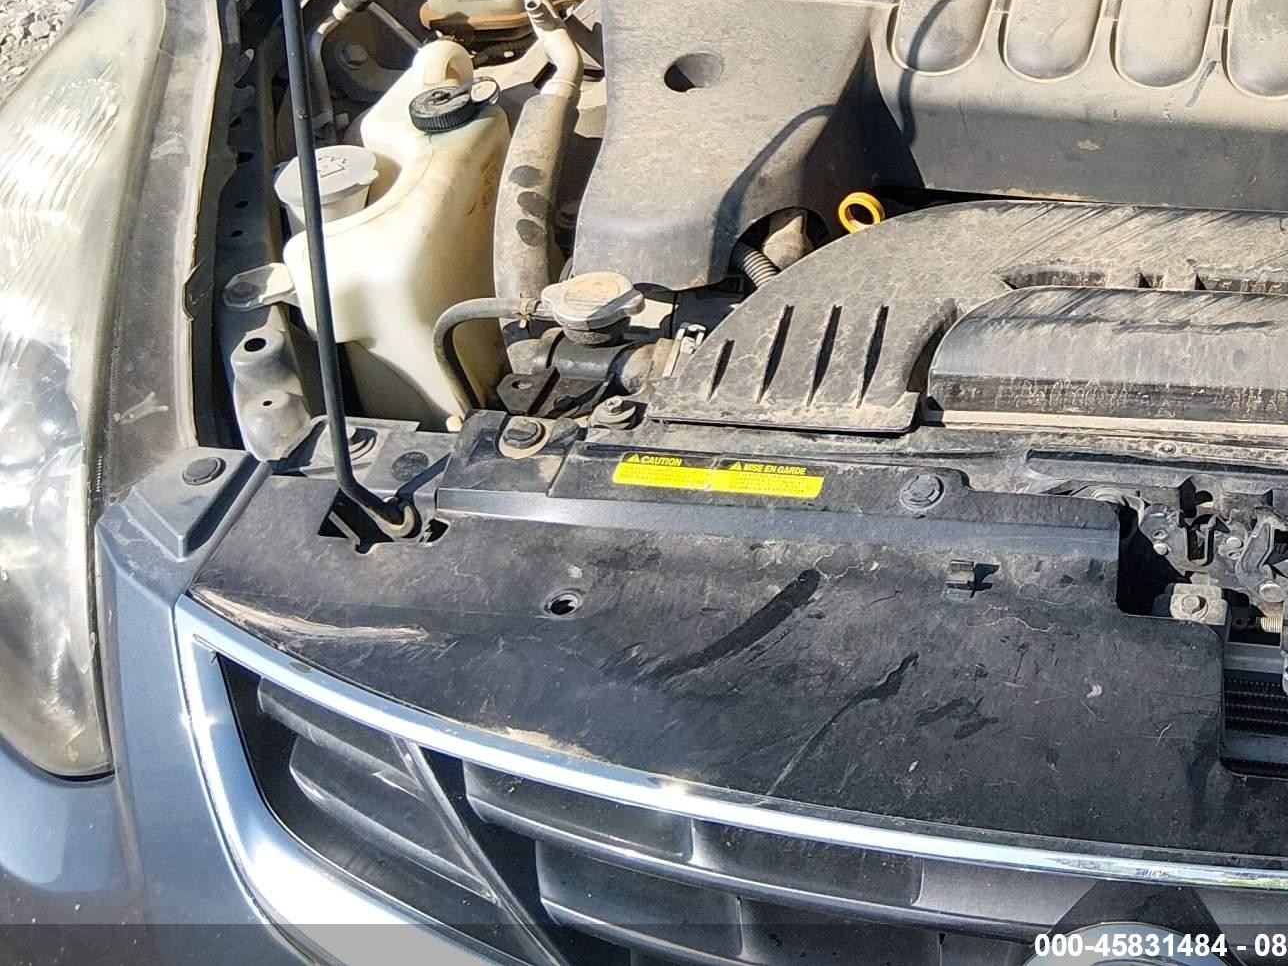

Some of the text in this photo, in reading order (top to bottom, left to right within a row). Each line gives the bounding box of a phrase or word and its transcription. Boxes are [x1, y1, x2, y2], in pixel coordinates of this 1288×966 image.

[641, 455, 683, 466] CAUTION
[743, 463, 807, 475] MISE EN GARDE
